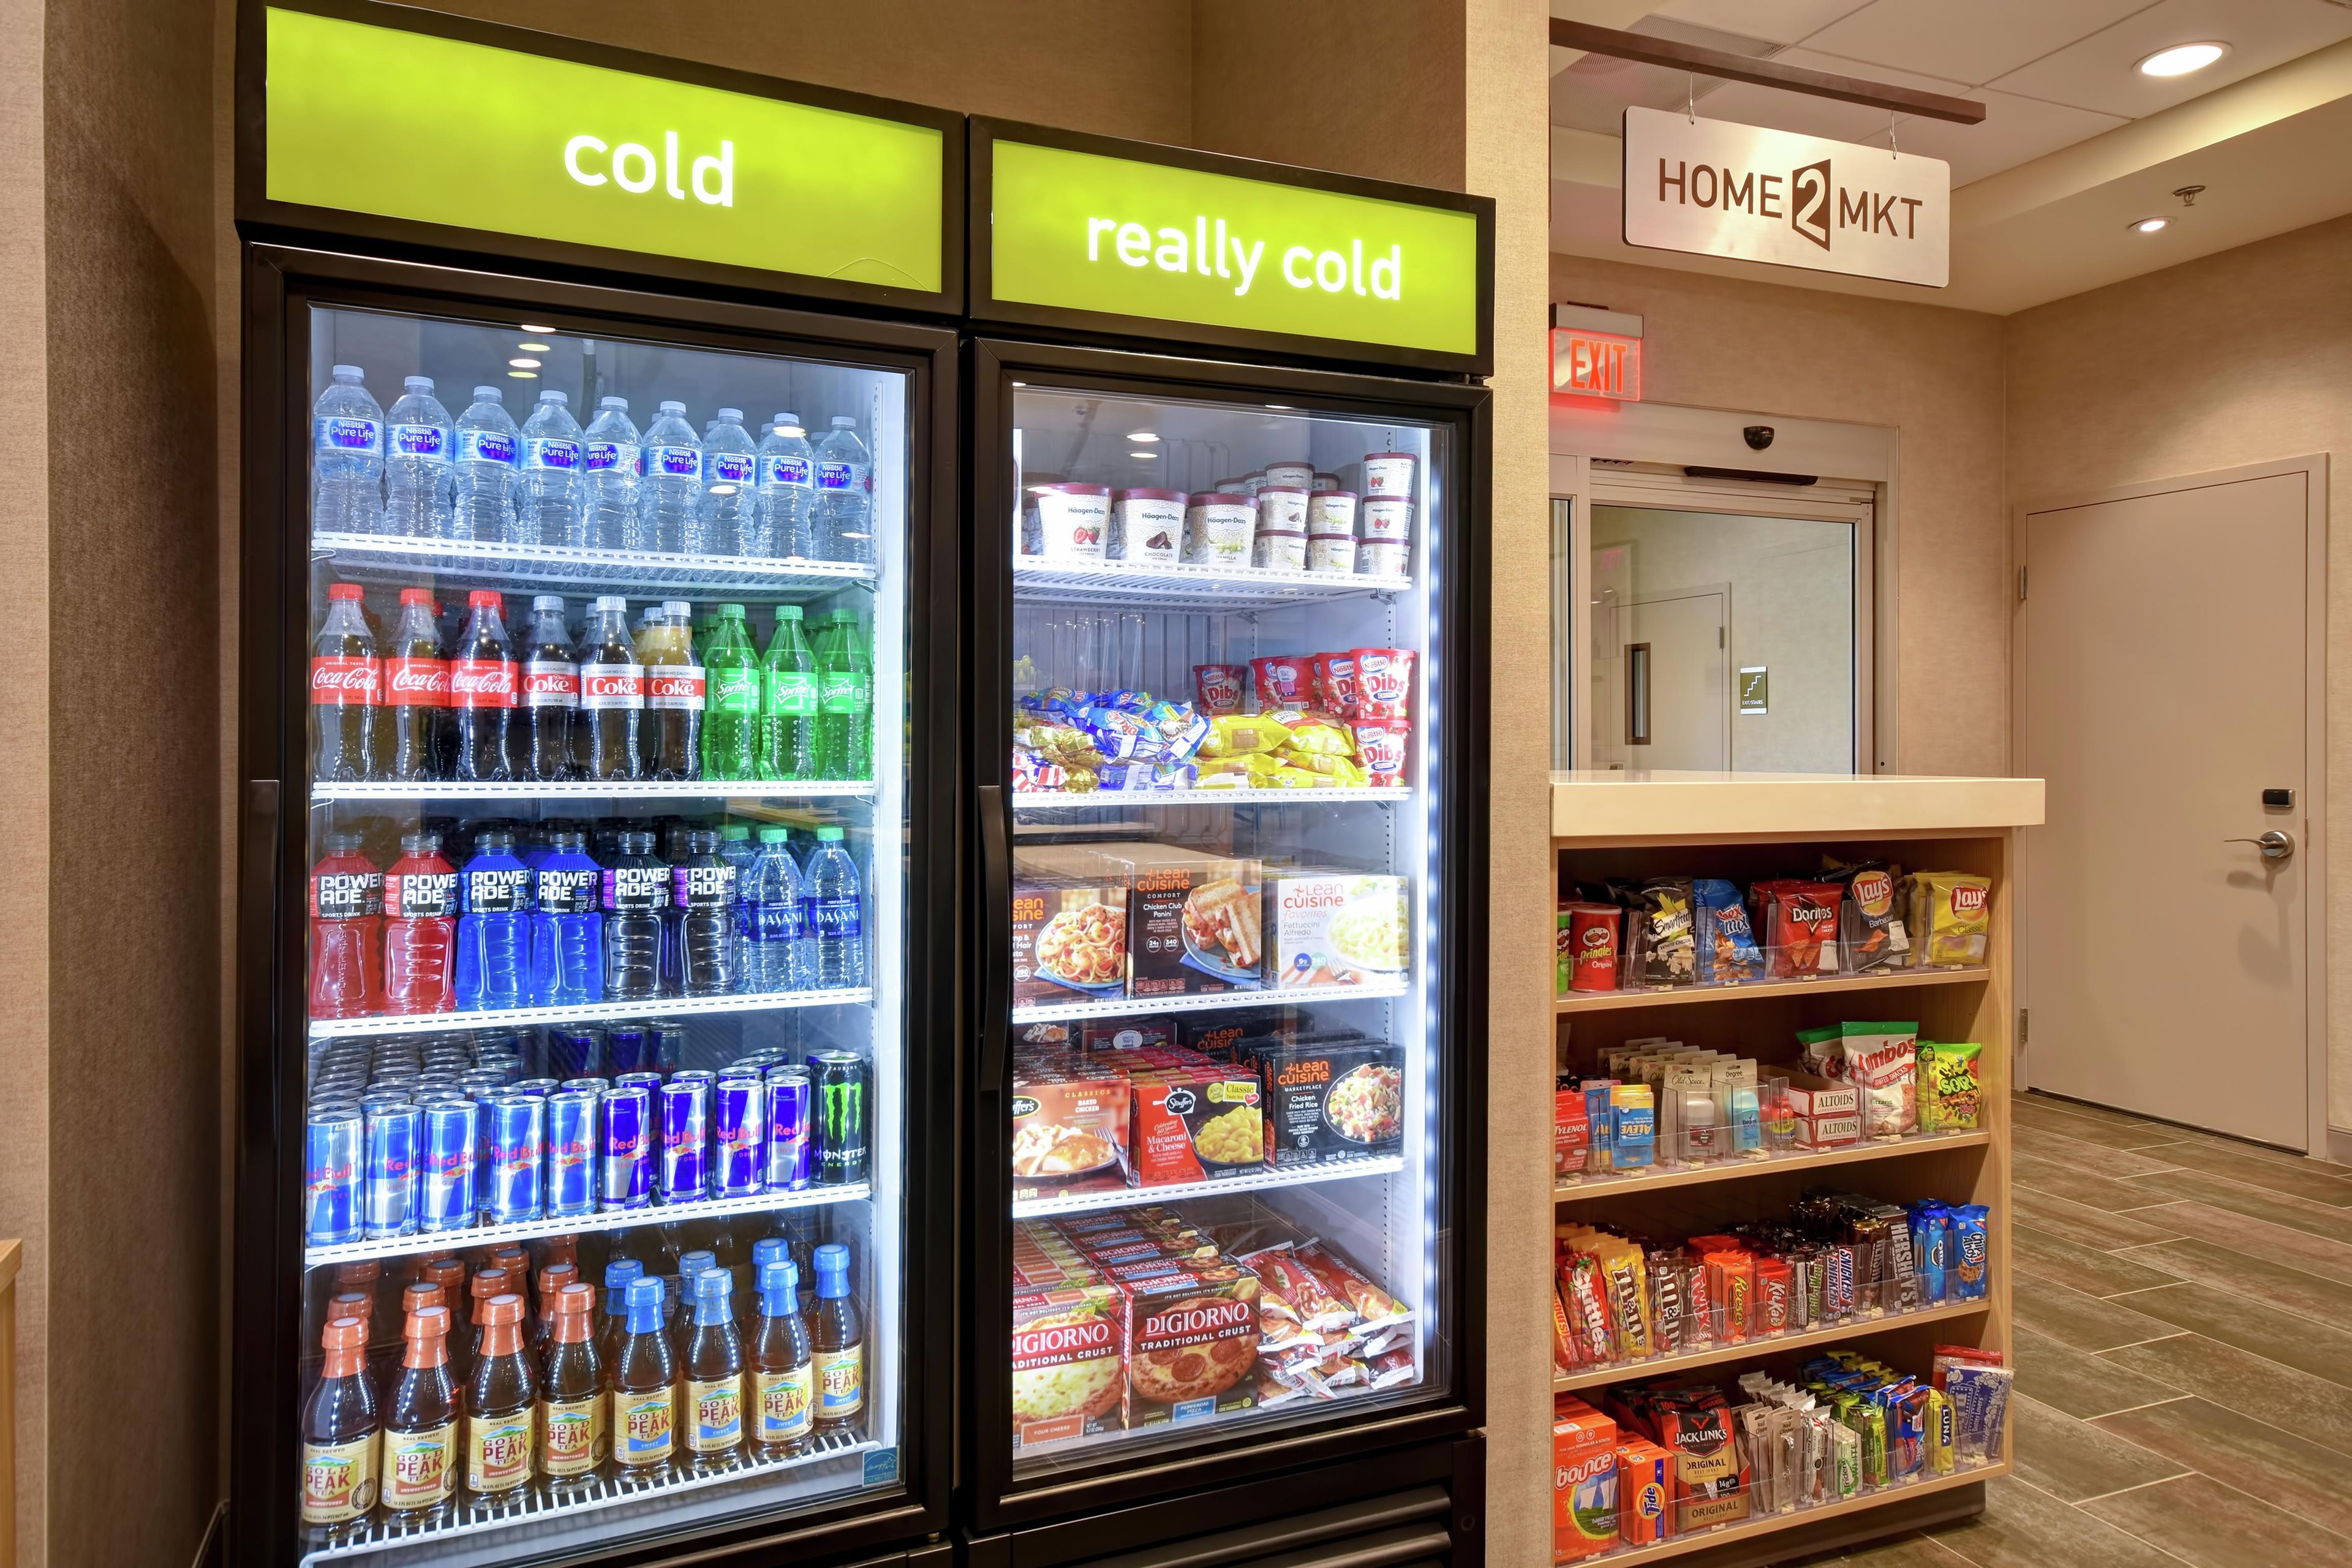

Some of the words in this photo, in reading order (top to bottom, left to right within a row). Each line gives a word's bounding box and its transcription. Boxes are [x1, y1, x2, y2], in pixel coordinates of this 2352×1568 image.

[564, 130, 734, 208] cold
[1086, 216, 1263, 298] really
[1281, 241, 1403, 301] cold
[1570, 338, 1627, 393] EXIT
[331, 426, 356, 435] Pure
[358, 430, 374, 440] Life
[399, 434, 423, 442] Pure
[424, 435, 440, 447] Life
[663, 454, 684, 463] Pure
[685, 458, 697, 468] Life
[1142, 513, 1180, 521] Häagen-Dazs
[313, 667, 378, 691] Coca-Cola
[453, 671, 512, 693] Coca-Cola
[524, 675, 569, 693] Coke
[592, 678, 637, 695] Coke
[1367, 675, 1406, 693] Dibs
[651, 680, 695, 696] Coke
[720, 683, 748, 696] Sprite
[778, 685, 809, 696] Sprite
[822, 685, 850, 696] Sprite
[1208, 685, 1239, 701] Dibs
[1363, 746, 1401, 763] Dibs
[539, 871, 597, 886] POWER
[1157, 868, 1189, 878] Lean
[1306, 883, 1343, 896] Lean
[1857, 878, 1890, 905] Lay's
[1014, 898, 1043, 909] ean
[1955, 888, 1987, 911] Lay's
[758, 910, 802, 927] DASANI
[817, 910, 859, 925] DASANI
[1282, 910, 1327, 922] favorites
[1793, 907, 1832, 922] Doritos
[1284, 921, 1320, 929] Fettuccini
[1958, 925, 1983, 934] Classic
[1580, 946, 1611, 965] Pringles
[1214, 1028, 1243, 1039] Lean
[1295, 1060, 1329, 1072] Lean
[1889, 1066, 1908, 1080] SNACKS
[1672, 1075, 1686, 1084] Old
[1686, 1075, 1705, 1085] Spice
[1226, 1084, 1254, 1093] Classic
[1168, 1098, 1193, 1109] Stouffer's
[1818, 1094, 1853, 1107] ALTOIDS
[717, 1126, 735, 1140] Red
[738, 1123, 761, 1138] Bull
[1555, 1124, 1587, 1135] TYLENOL
[1822, 1121, 1857, 1134] ALTOIDS
[682, 1127, 705, 1144] Bull
[1147, 1132, 1186, 1145] Macaroni
[494, 1147, 518, 1159] Red
[521, 1142, 544, 1158] Bull
[814, 1147, 866, 1161] MONSTER
[1156, 1142, 1186, 1152] Cheese
[1970, 1232, 1984, 1261] Chips
[1890, 1223, 1916, 1302] HERSHEY'S
[1828, 1258, 1838, 1308] SNICKERS
[1840, 1249, 1853, 1302] SNICKERS
[1691, 1265, 1711, 1331] TWIX
[1013, 1324, 1110, 1355] IGIORNO
[1141, 1334, 1214, 1350] TRADITIONAL
[1218, 1325, 1251, 1338] CRUST
[1013, 1355, 1072, 1370] ADITIONAL
[1077, 1346, 1113, 1359] CRUST
[1181, 1401, 1209, 1410] PEPPERONI
[628, 1408, 669, 1420] GOLD
[628, 1415, 669, 1433] PEAK
[1942, 1408, 1951, 1444] LUNA
[483, 1431, 527, 1446] GOLD
[1675, 1433, 1700, 1444] JACK
[1700, 1429, 1727, 1441] LINK'S
[397, 1450, 443, 1461] GOLD
[483, 1439, 527, 1460] PEAK
[396, 1457, 443, 1476] PEAK
[1556, 1453, 1613, 1487] bounce
[1687, 1459, 1726, 1469] ORIGINAL
[1643, 1487, 1660, 1516] Tide
[1692, 1501, 1738, 1518] ORIGINAL
